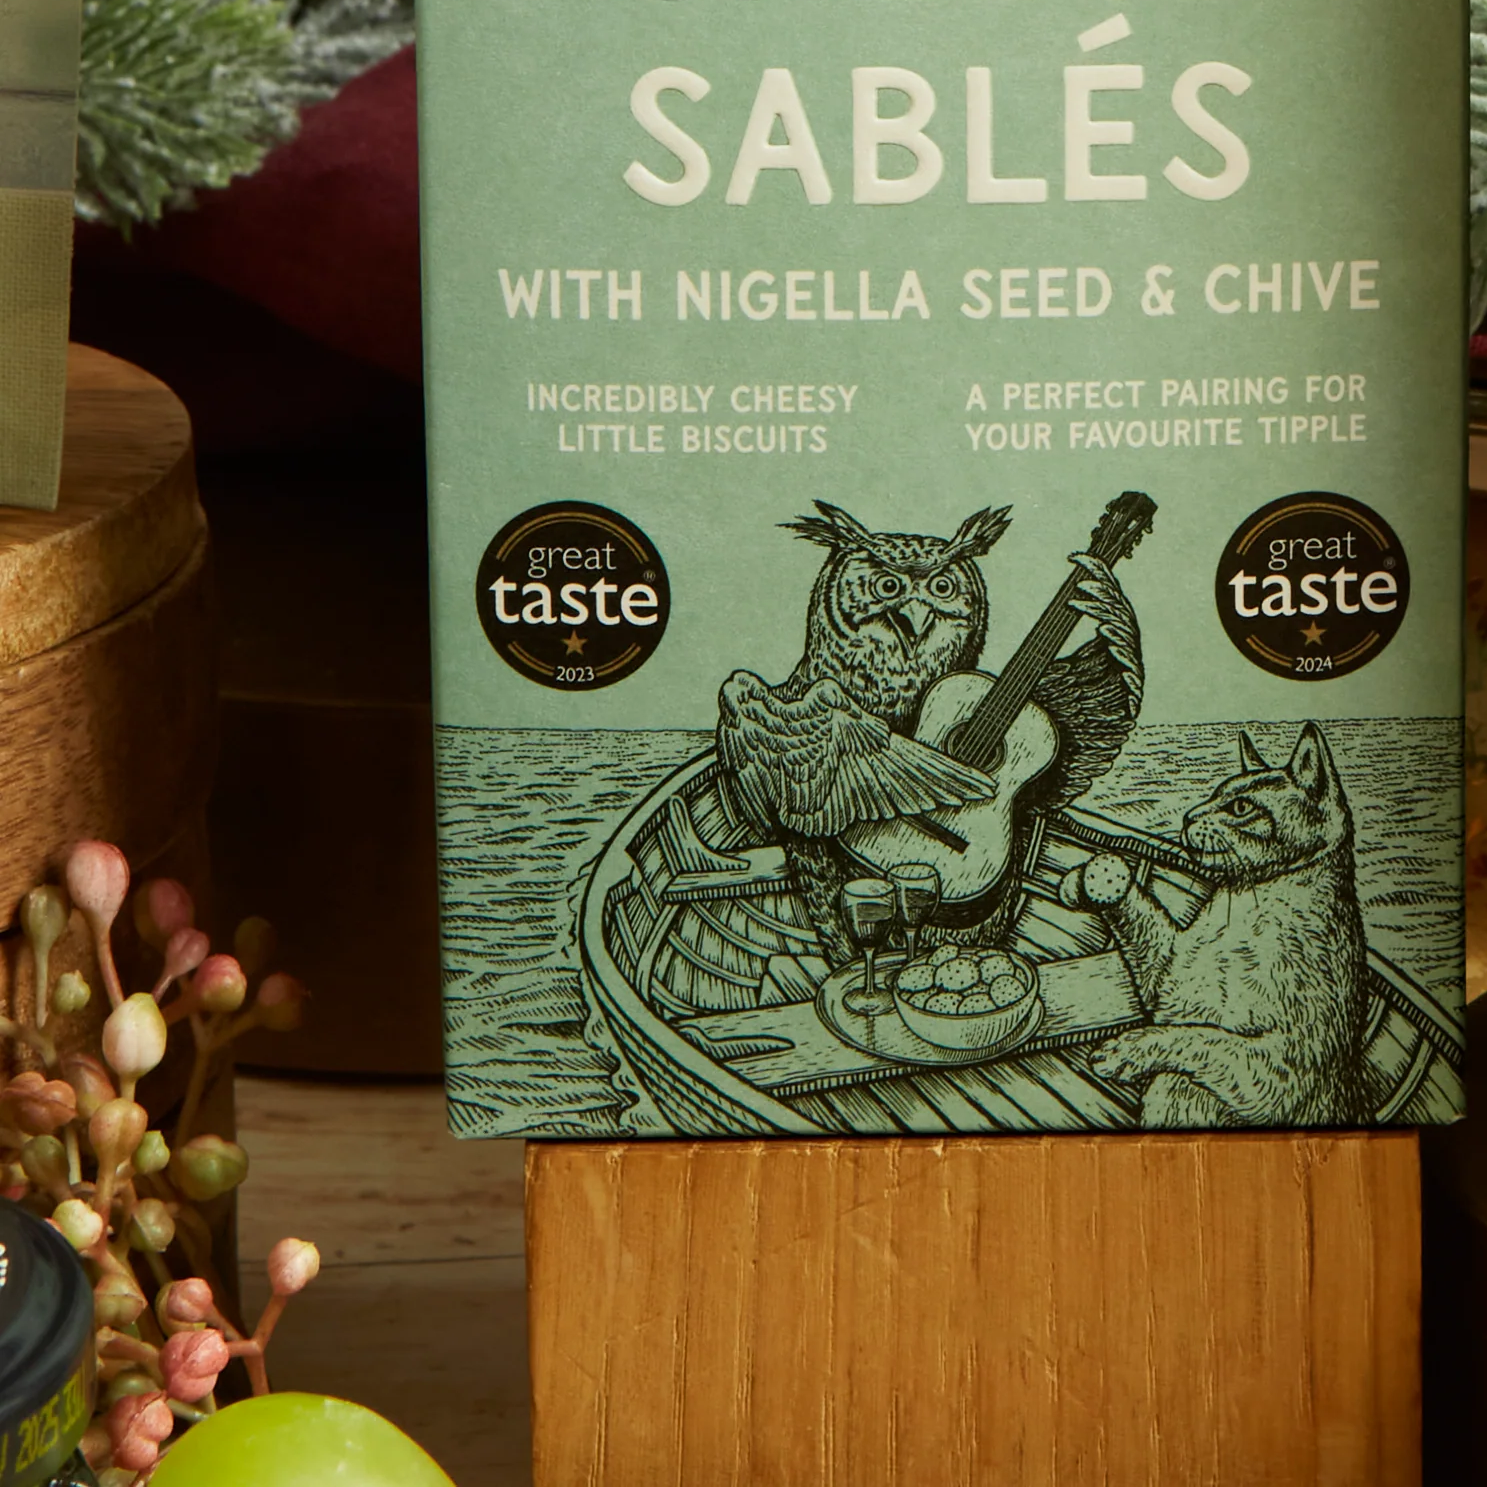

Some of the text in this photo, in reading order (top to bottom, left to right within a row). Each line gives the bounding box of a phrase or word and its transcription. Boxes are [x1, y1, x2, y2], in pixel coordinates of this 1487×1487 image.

[623, 13, 1253, 207] SABLÉS
[498, 260, 1381, 321] WITH NIGELLA SEED & CHIVE
[527, 383, 859, 413] INCREDIBLY CHEESY
[965, 374, 1367, 411] A PERFECT PAIRING FOR
[558, 424, 828, 453] LITTLE BISCUITS
[965, 414, 1367, 451] YOUR FAVOURITE TIPPLE
[528, 542, 617, 578] great
[1268, 531, 1357, 571] great
[489, 575, 659, 626] taste
[1228, 566, 1398, 618] taste
[556, 666, 595, 682] 2023
[1295, 656, 1333, 672] 2024
